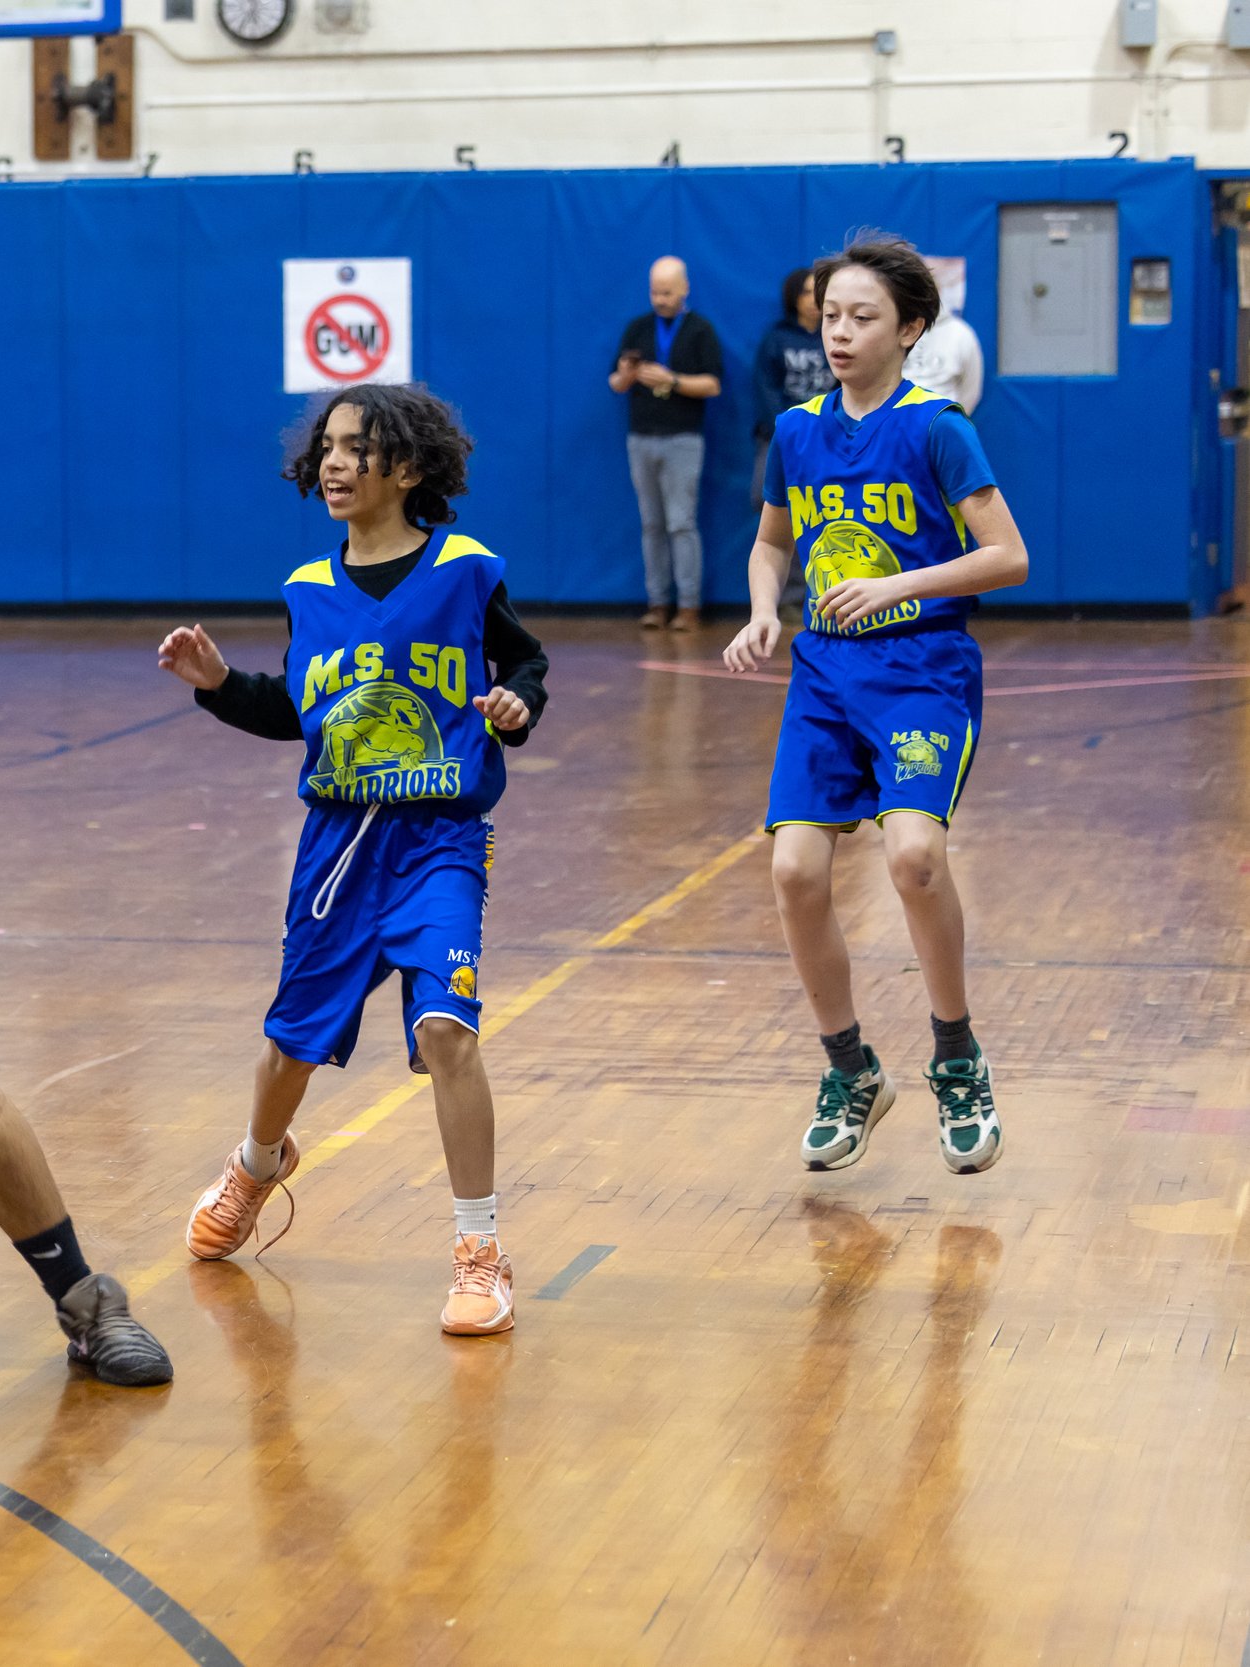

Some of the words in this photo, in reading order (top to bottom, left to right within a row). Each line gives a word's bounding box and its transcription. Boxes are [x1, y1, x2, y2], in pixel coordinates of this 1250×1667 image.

[884, 136, 906, 162] 3
[1108, 132, 1130, 158] 2
[314, 323, 379, 355] GUM
[787, 484, 854, 541] M.S.
[862, 482, 918, 536] 50
[301, 642, 394, 713] M.S.
[409, 642, 467, 709] 50
[929, 731, 949, 751] 50
[447, 949, 471, 964] MS
